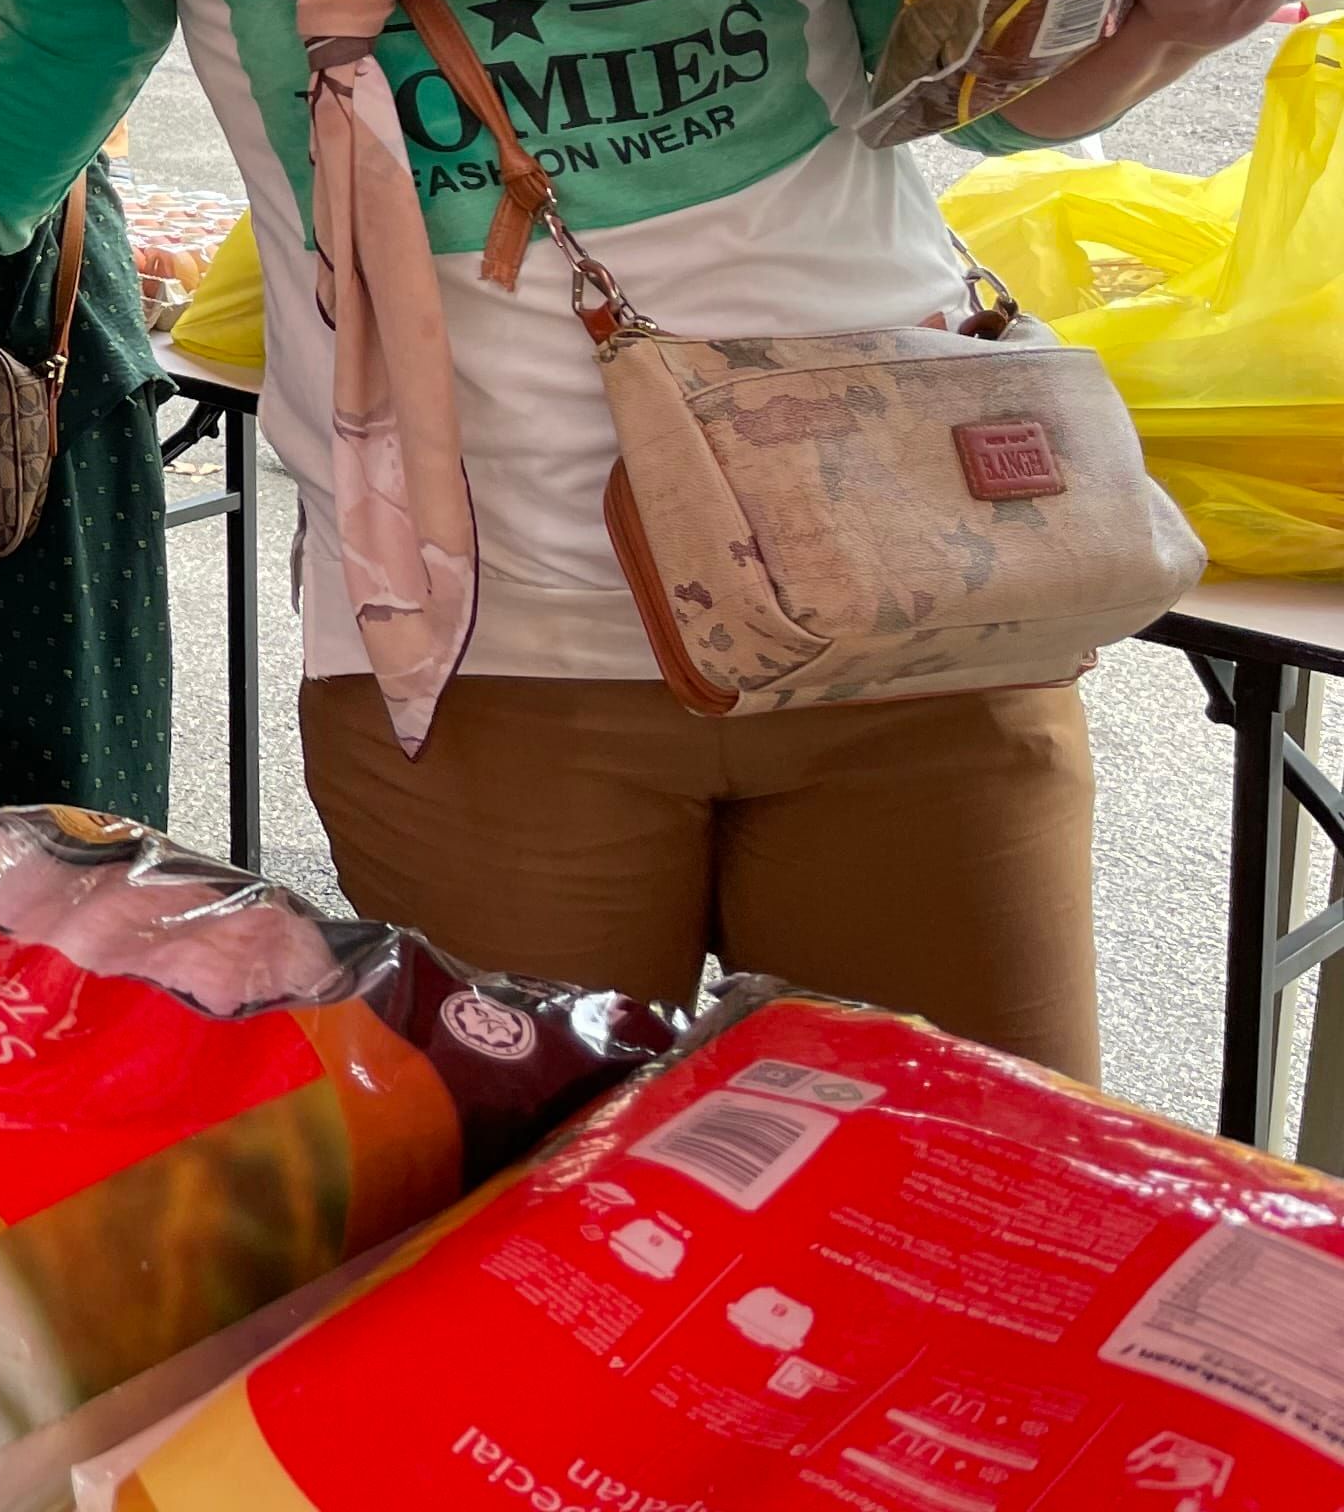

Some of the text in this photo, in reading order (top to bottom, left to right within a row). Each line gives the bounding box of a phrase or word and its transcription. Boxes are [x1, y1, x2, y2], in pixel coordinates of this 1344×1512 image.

[412, 104, 736, 197] ASHON WEAR
[450, 1424, 598, 1512] ecial
[566, 1456, 710, 1512] patan
